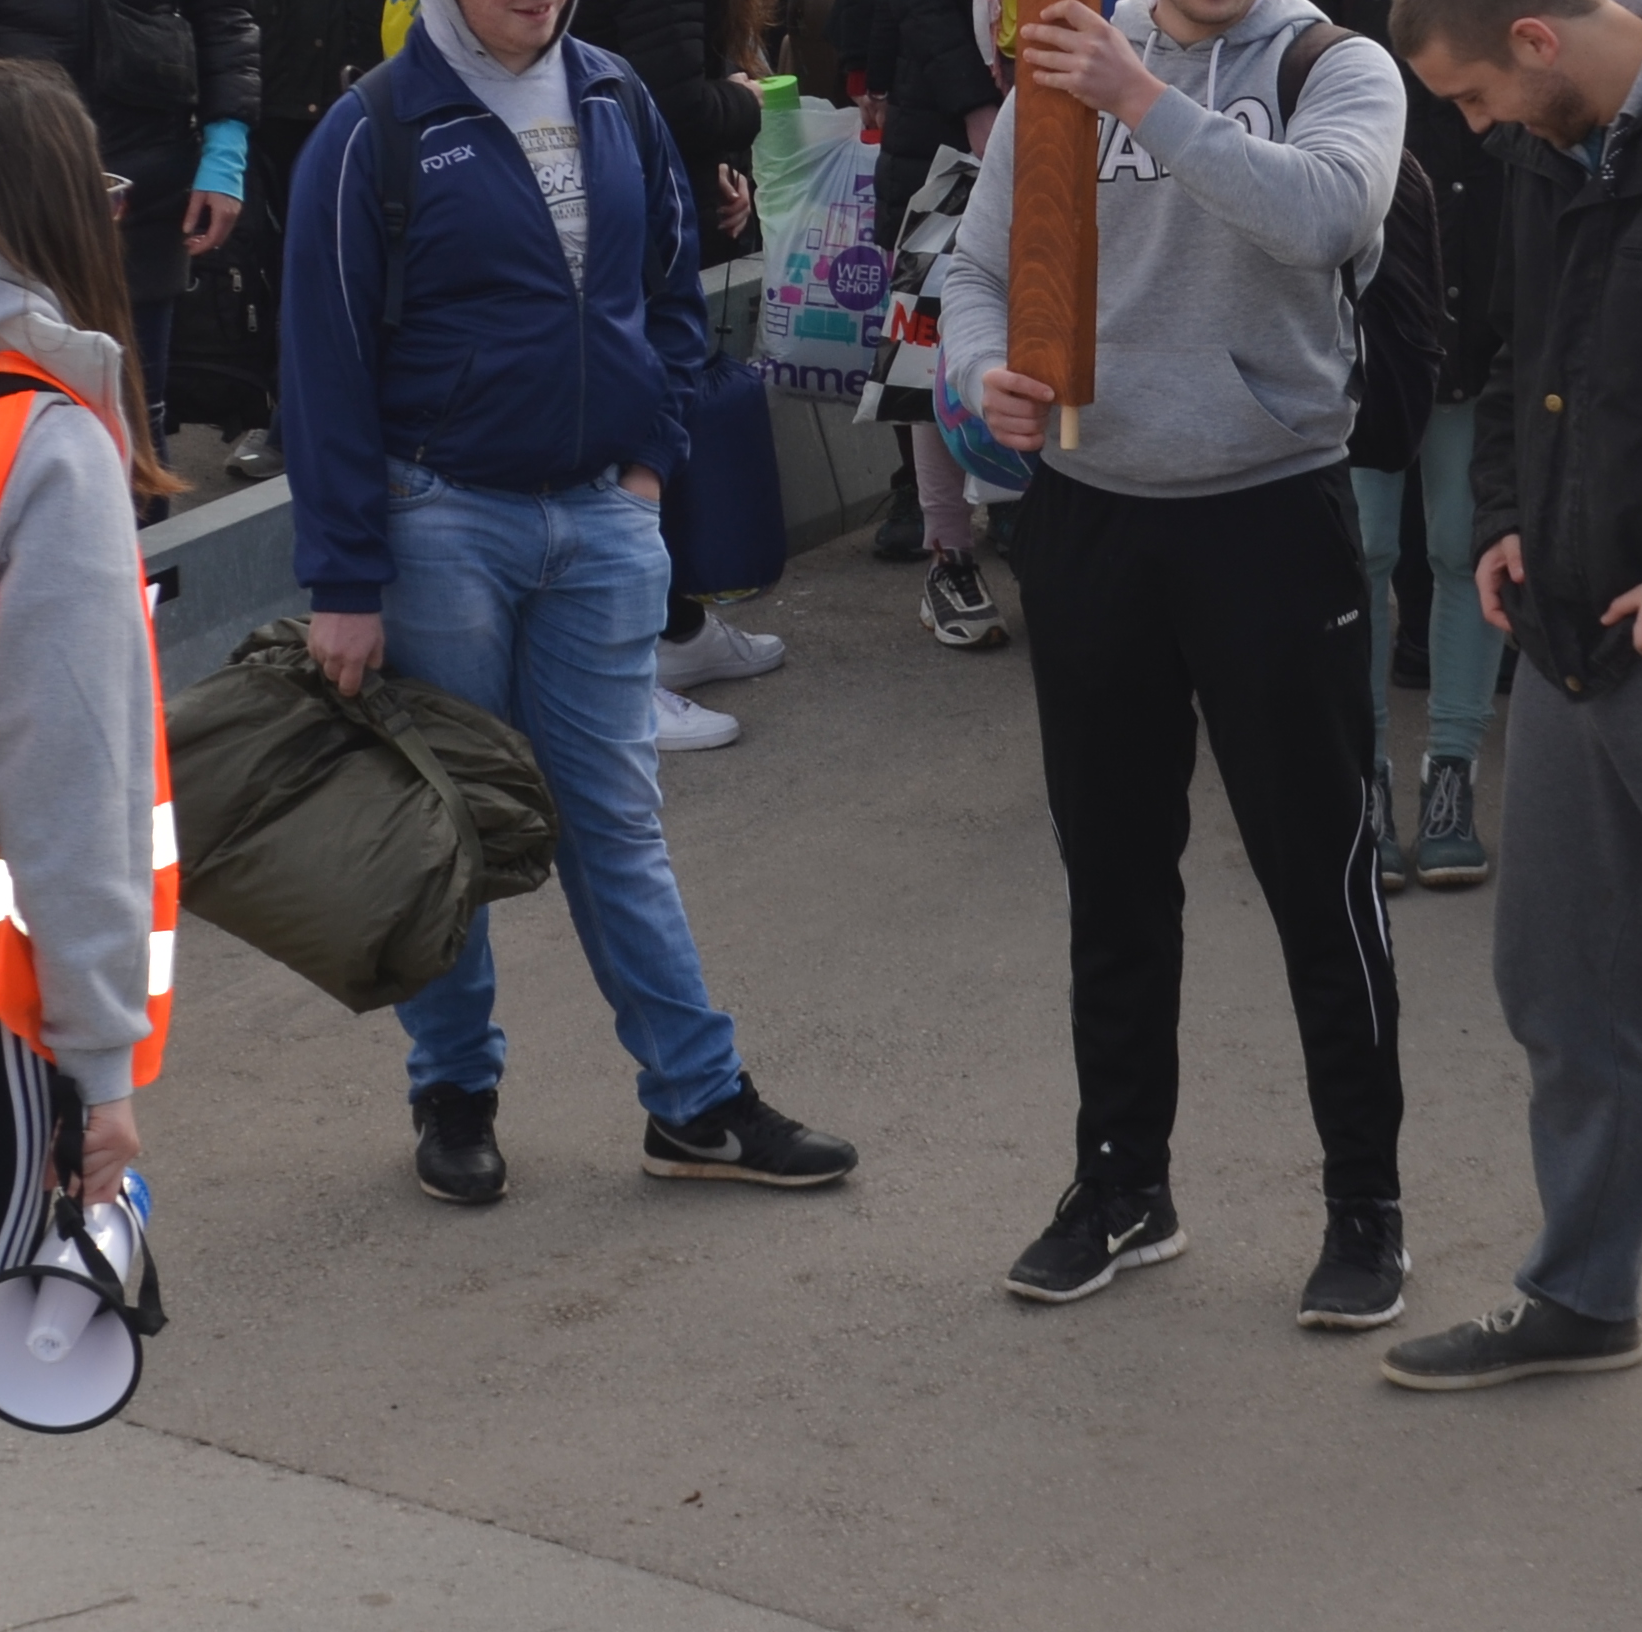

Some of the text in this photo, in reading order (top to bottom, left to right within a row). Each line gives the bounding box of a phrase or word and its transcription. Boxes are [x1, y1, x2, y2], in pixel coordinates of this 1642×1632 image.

[420, 144, 476, 174] FOTEX
[837, 262, 882, 283] WEB
[835, 280, 880, 295] SHOP
[890, 301, 940, 348] NE
